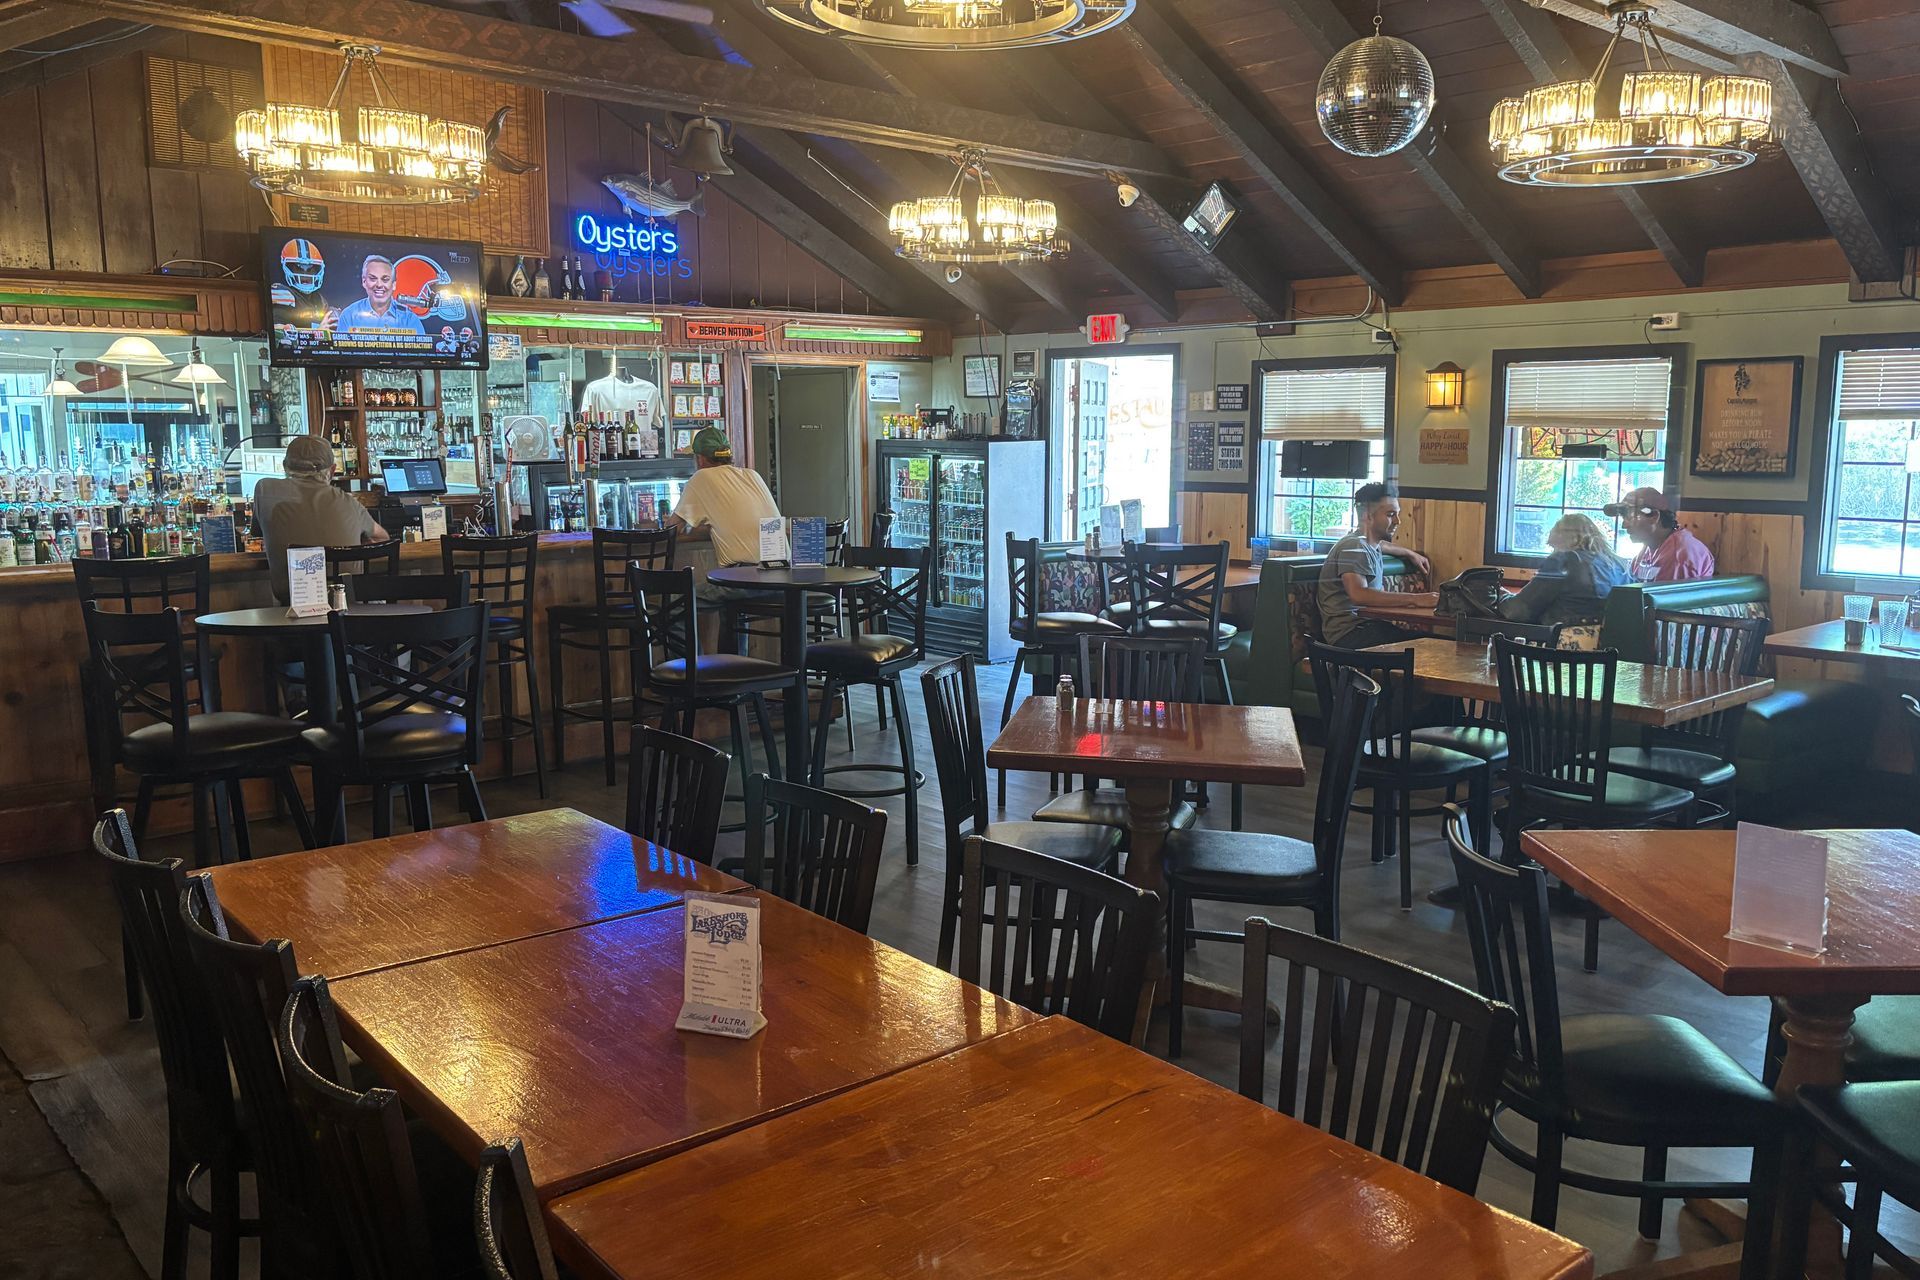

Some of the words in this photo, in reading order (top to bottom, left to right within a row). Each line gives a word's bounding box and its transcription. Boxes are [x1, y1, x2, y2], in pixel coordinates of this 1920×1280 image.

[579, 215, 677, 252] Oysters
[699, 326, 726, 336] BEAVER
[729, 327, 753, 336] NATION
[1092, 316, 1118, 342] EXIT
[489, 335, 519, 346] NOCE
[1709, 431, 1728, 439] MAKES
[1749, 430, 1771, 438] PIRATE
[1421, 442, 1442, 450] HAPPY
[1448, 442, 1467, 450] HOUR
[1221, 448, 1234, 457] STAYS
[691, 912, 748, 933] LAKESHORE
[709, 927, 747, 944] LODGE
[718, 1017, 746, 1026] ULTRA
